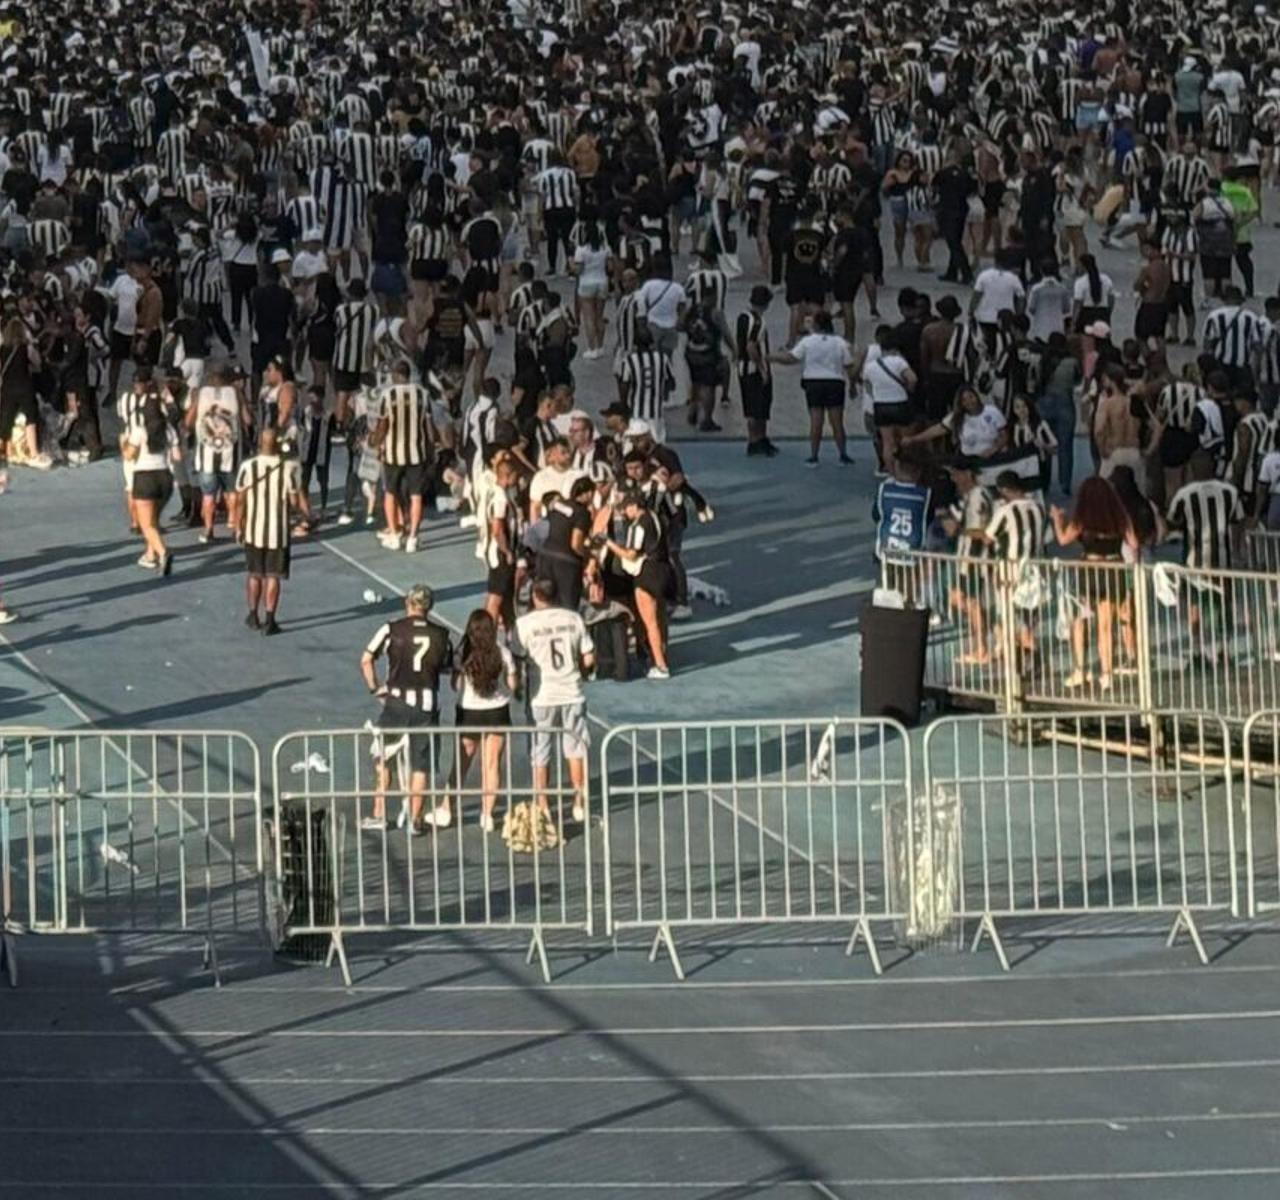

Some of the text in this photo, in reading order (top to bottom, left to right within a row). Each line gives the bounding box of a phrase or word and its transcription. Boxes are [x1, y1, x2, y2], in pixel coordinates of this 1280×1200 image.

[890, 511, 913, 537] 25
[413, 635, 431, 673] 7
[550, 637, 565, 671] 6
